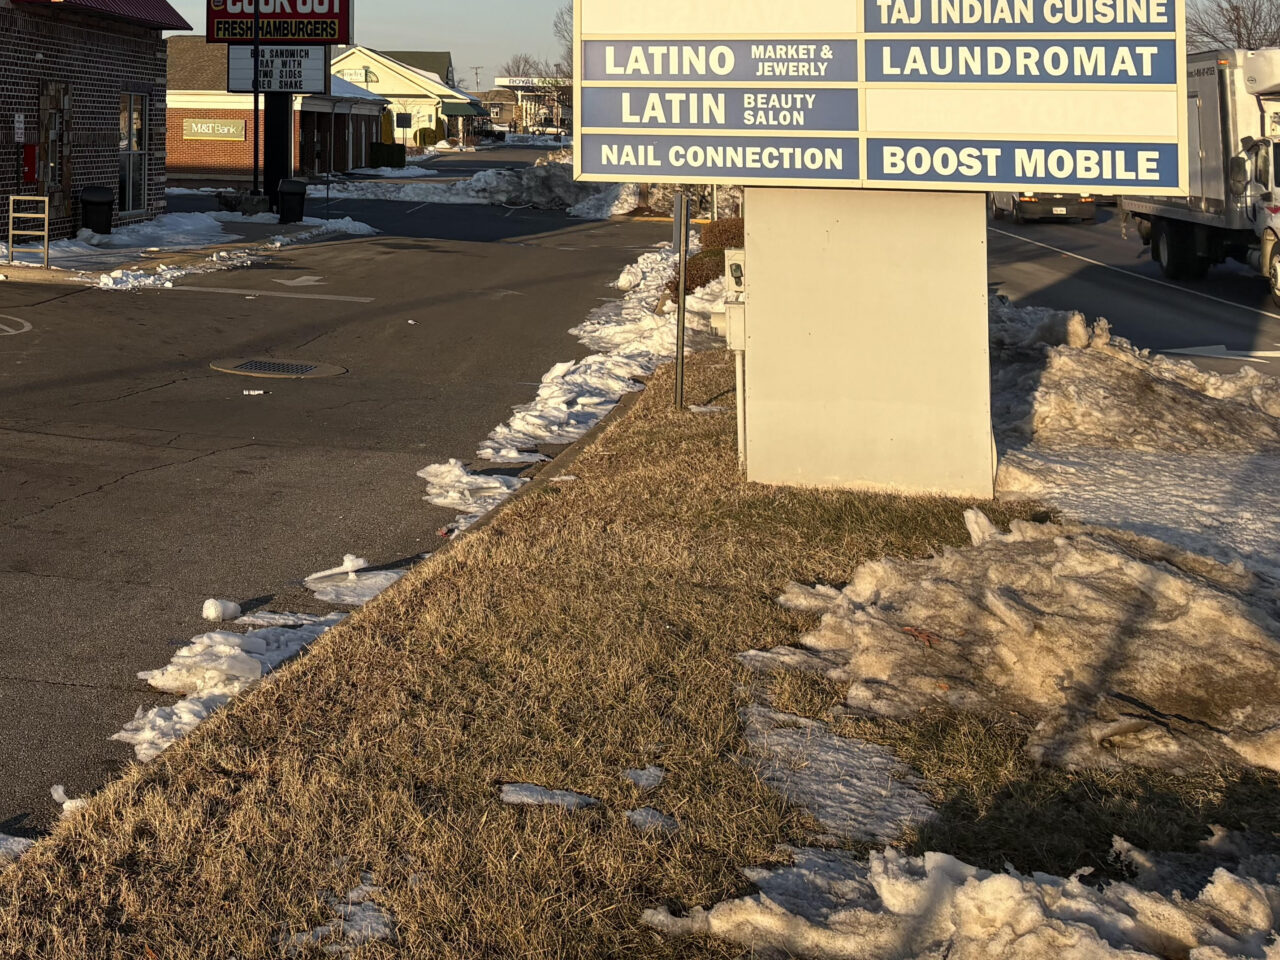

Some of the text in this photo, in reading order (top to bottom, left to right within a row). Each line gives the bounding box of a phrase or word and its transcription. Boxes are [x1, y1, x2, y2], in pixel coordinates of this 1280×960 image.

[216, 20, 337, 38] FRESH HAMBURGERS
[269, 49, 309, 59] SANDWICH
[605, 44, 834, 76] LATINO MARKET &
[882, 46, 1158, 76] LAUNDROMAT
[258, 59, 302, 69] RAY WITH
[756, 62, 828, 77] JEWERLY
[259, 69, 302, 79] TWO SIDES
[278, 80, 303, 90] SHAKE
[508, 78, 536, 86] ROYAL
[621, 93, 817, 125] LATIN BEAUTY
[743, 110, 805, 126] SALON
[191, 122, 237, 134] M&T Bank
[601, 145, 844, 171] NAIL CONNECTION
[882, 146, 1160, 180] BOOST MOBILE
